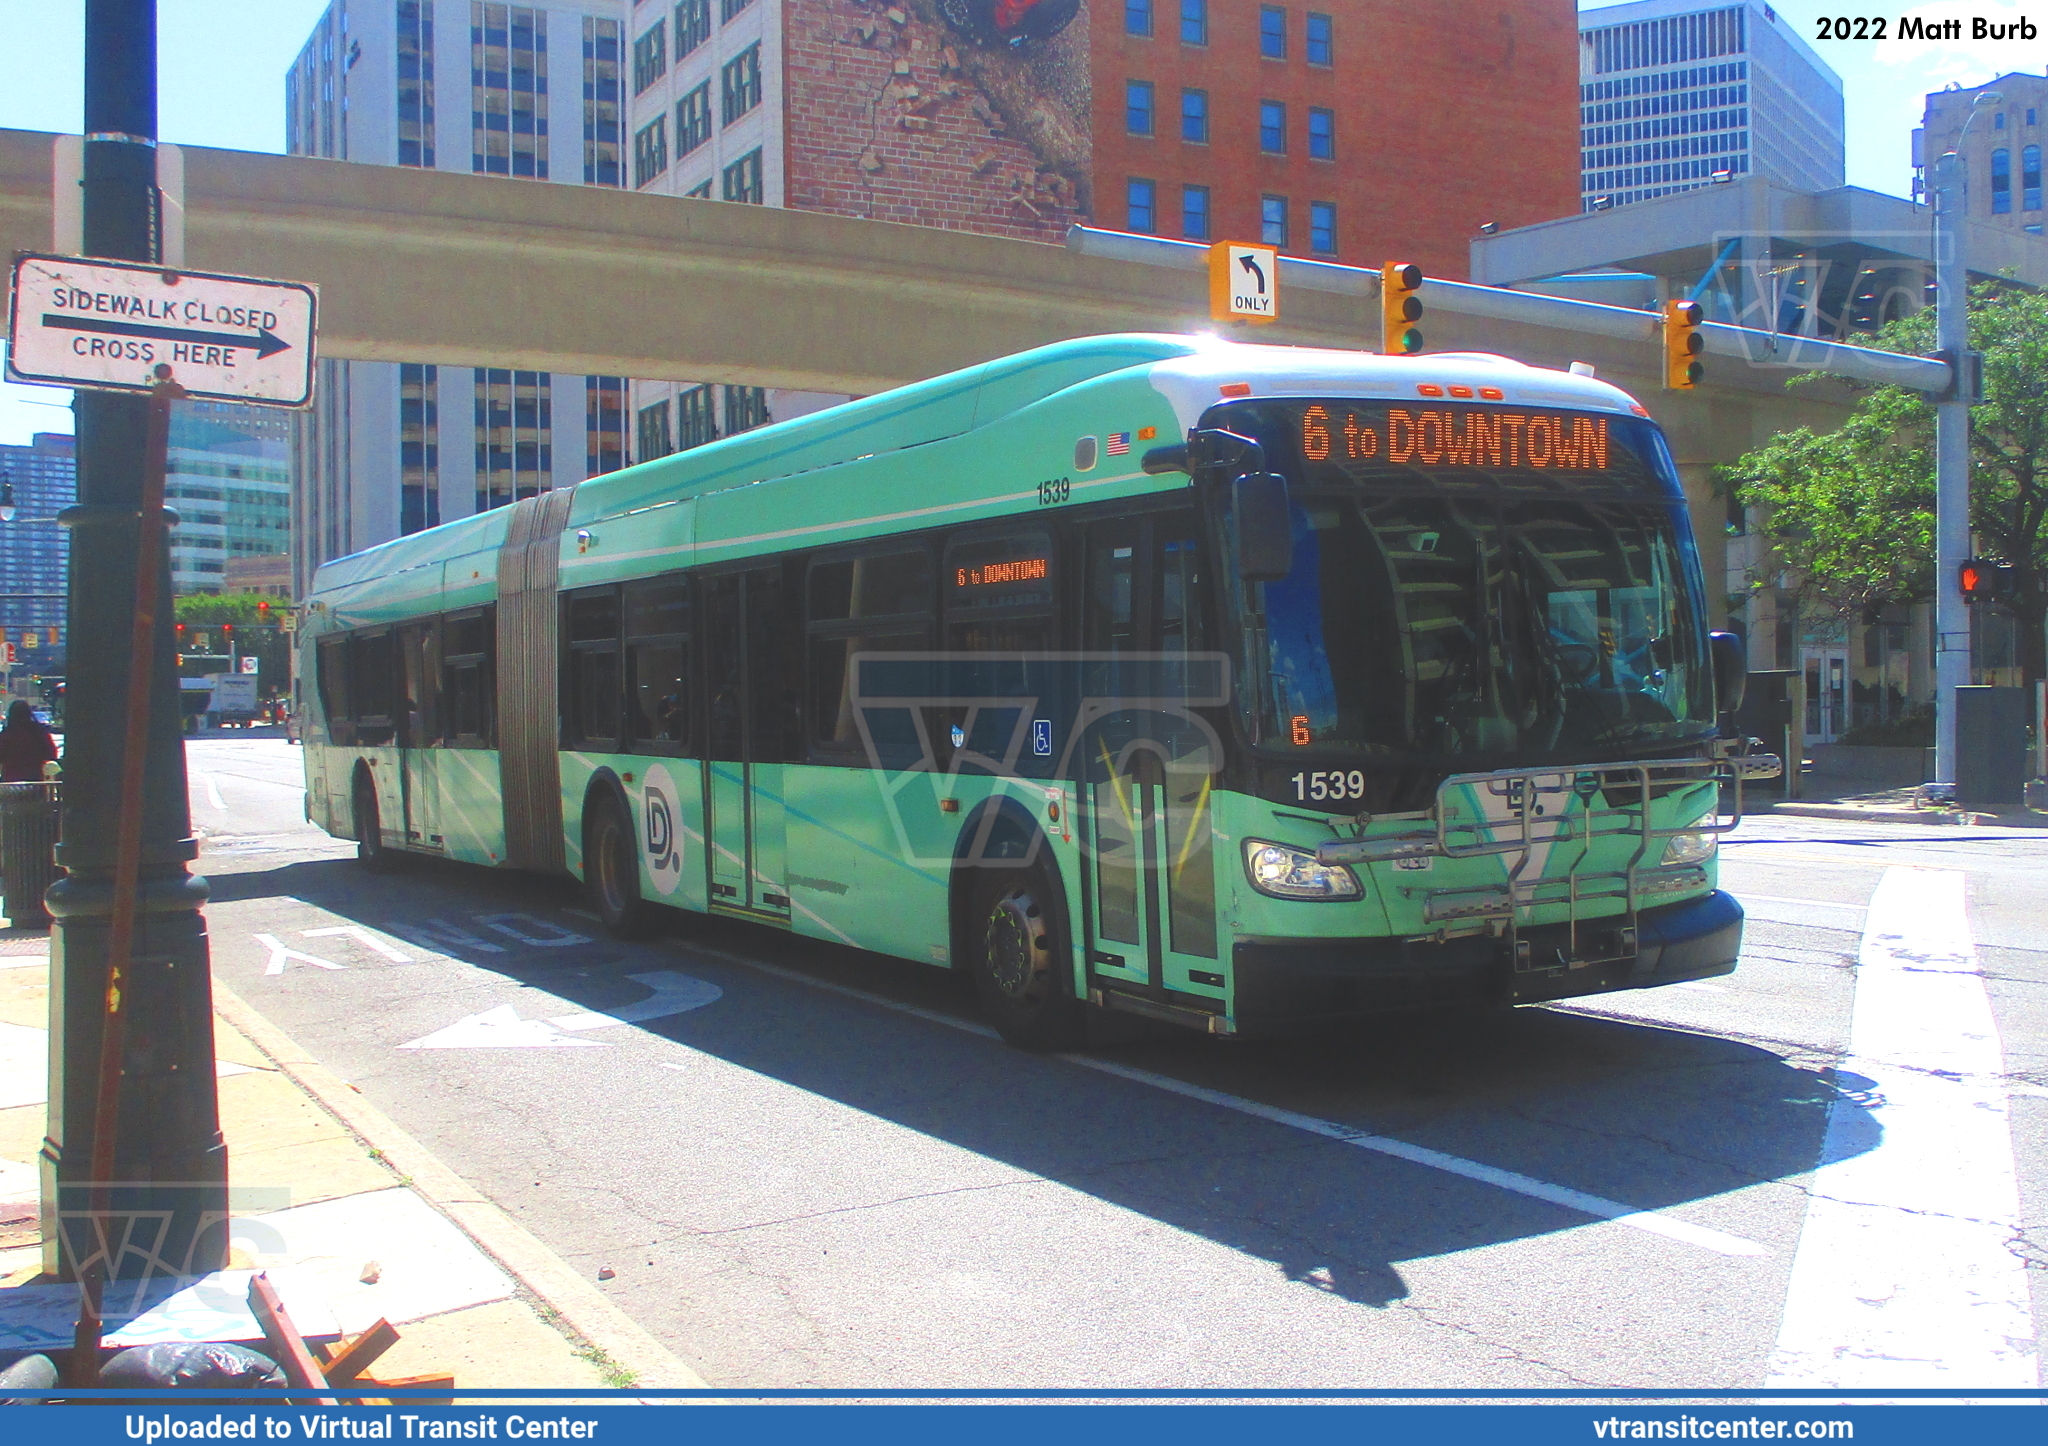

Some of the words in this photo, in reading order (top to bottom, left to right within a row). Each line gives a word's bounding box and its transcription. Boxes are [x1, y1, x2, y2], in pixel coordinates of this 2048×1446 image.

[53, 288, 177, 320] SIDEWALK
[184, 301, 277, 330] CLOSED
[1235, 295, 1269, 311] ONLY
[73, 337, 154, 362] CROSS
[174, 343, 236, 367] HERE
[1304, 405, 1329, 460] 6
[1343, 413, 1377, 458] to
[1389, 408, 1606, 469] DOWNTOWN
[1037, 477, 1070, 505] 1539
[957, 568, 966, 586] 6
[971, 569, 980, 584] to
[984, 559, 1045, 584] DOWNTOWN
[1292, 715, 1309, 745] 6
[1291, 770, 1364, 801] 1539
[252, 913, 593, 976] ONLY
